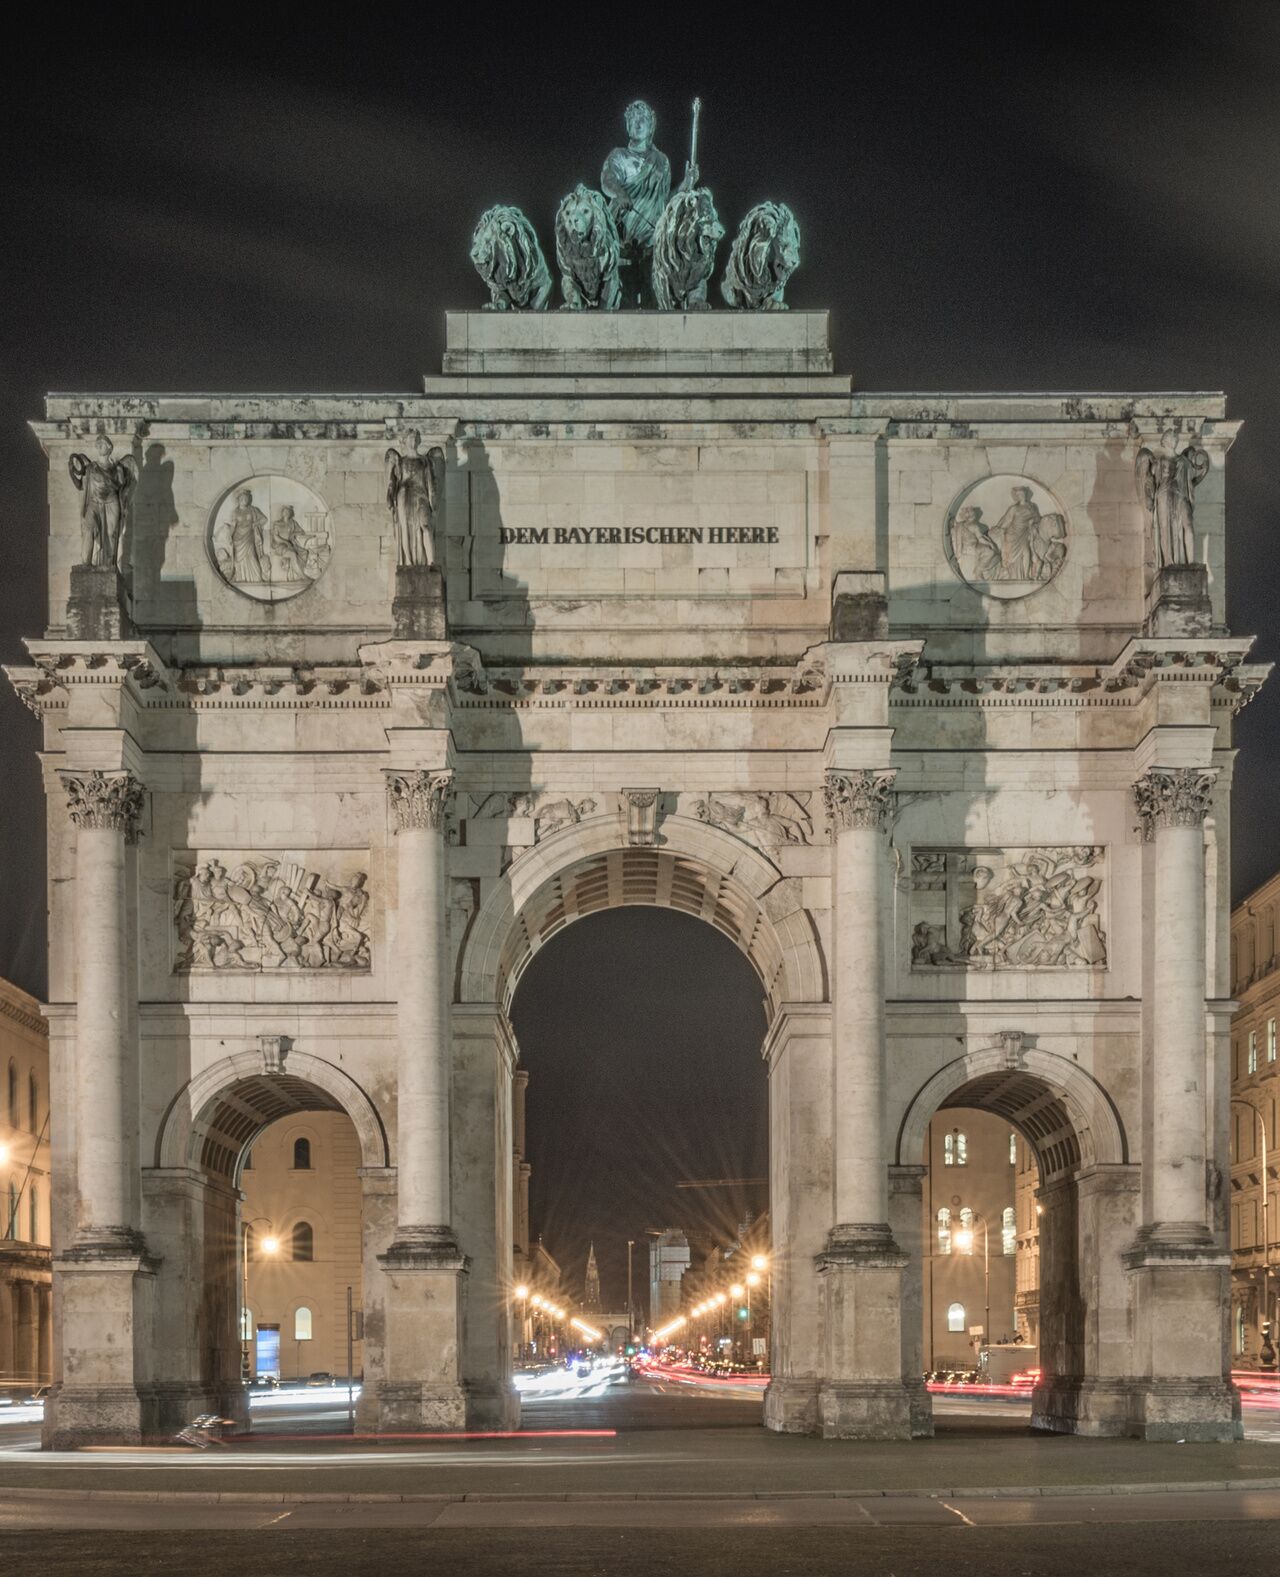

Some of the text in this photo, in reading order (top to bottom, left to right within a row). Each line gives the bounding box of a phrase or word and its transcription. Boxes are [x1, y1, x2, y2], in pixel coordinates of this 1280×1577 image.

[498, 526, 779, 544] DEM BAYERISCHEN HEERE
